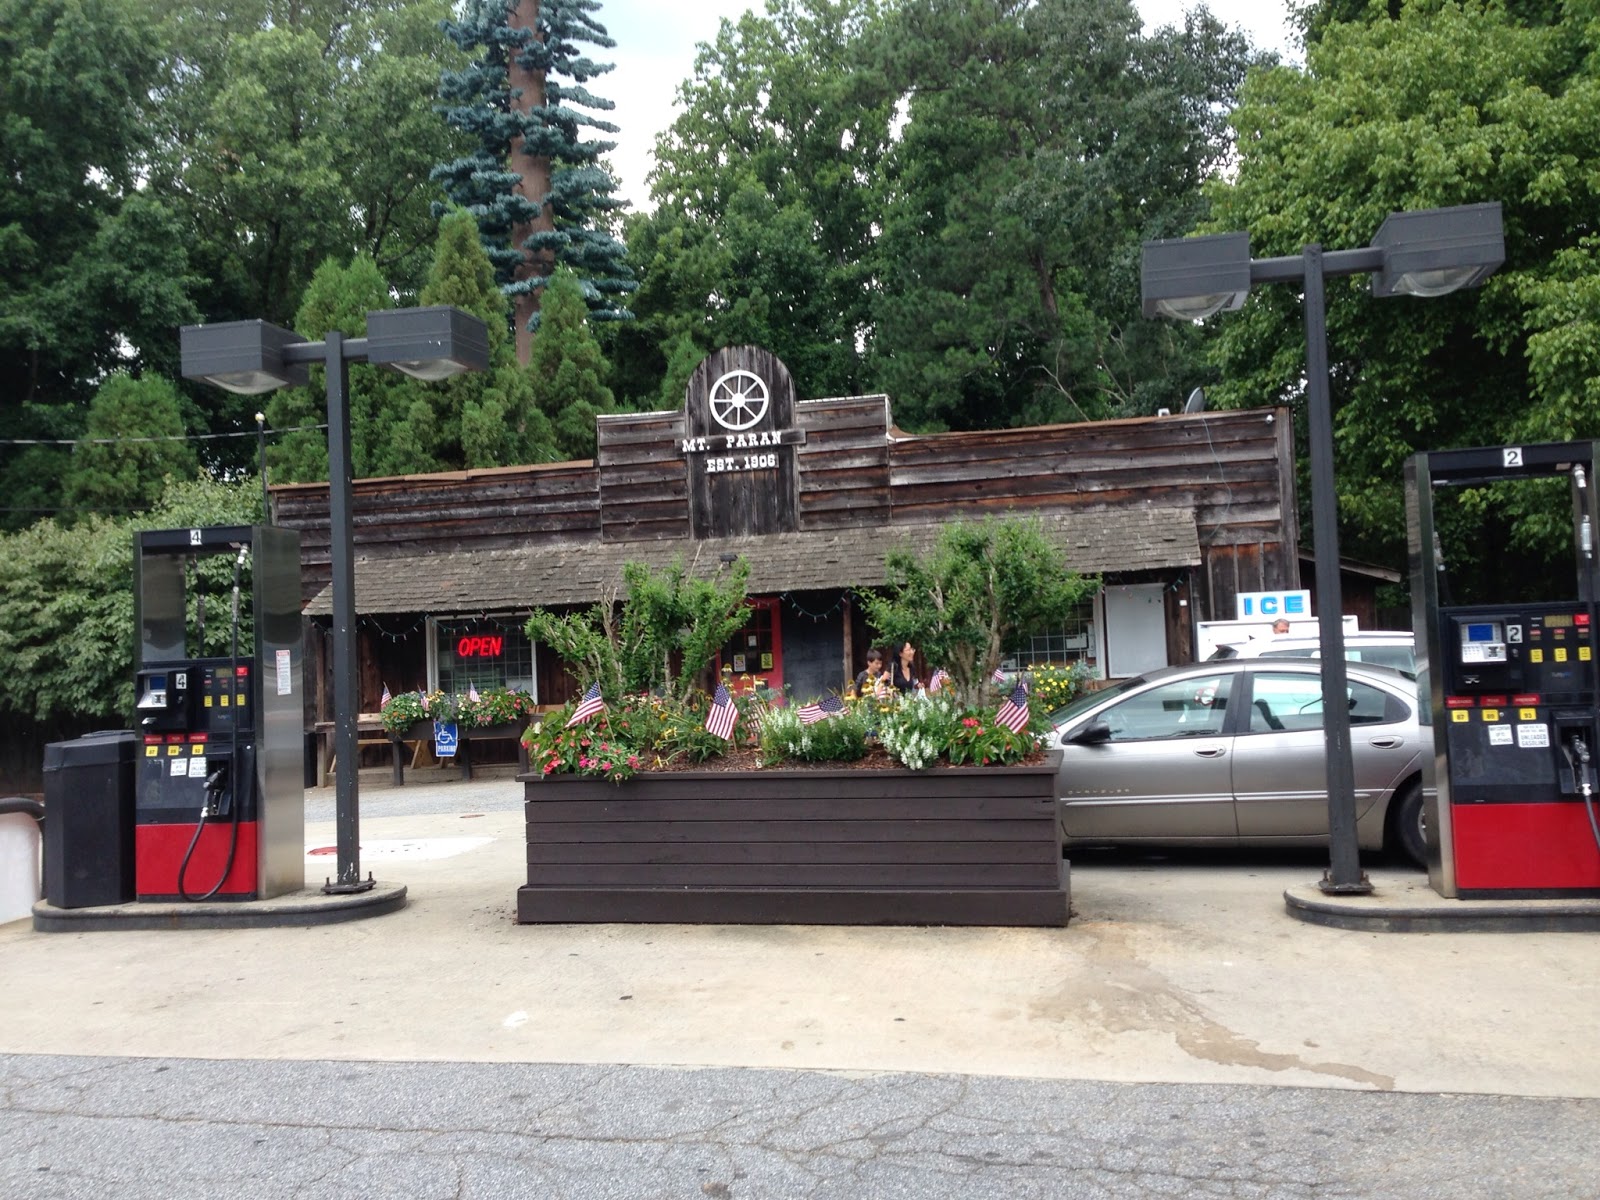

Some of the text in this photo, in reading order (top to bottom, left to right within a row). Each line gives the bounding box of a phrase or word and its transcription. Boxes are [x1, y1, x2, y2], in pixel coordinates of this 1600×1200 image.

[682, 431, 782, 452] MT. PARAN
[706, 454, 775, 472] EST. 1906
[1507, 450, 1519, 465] 2
[191, 531, 201, 543] 4
[1244, 595, 1304, 616] ICE
[1509, 626, 1520, 642] 2
[458, 637, 502, 656] OPEN
[177, 674, 185, 688] 4
